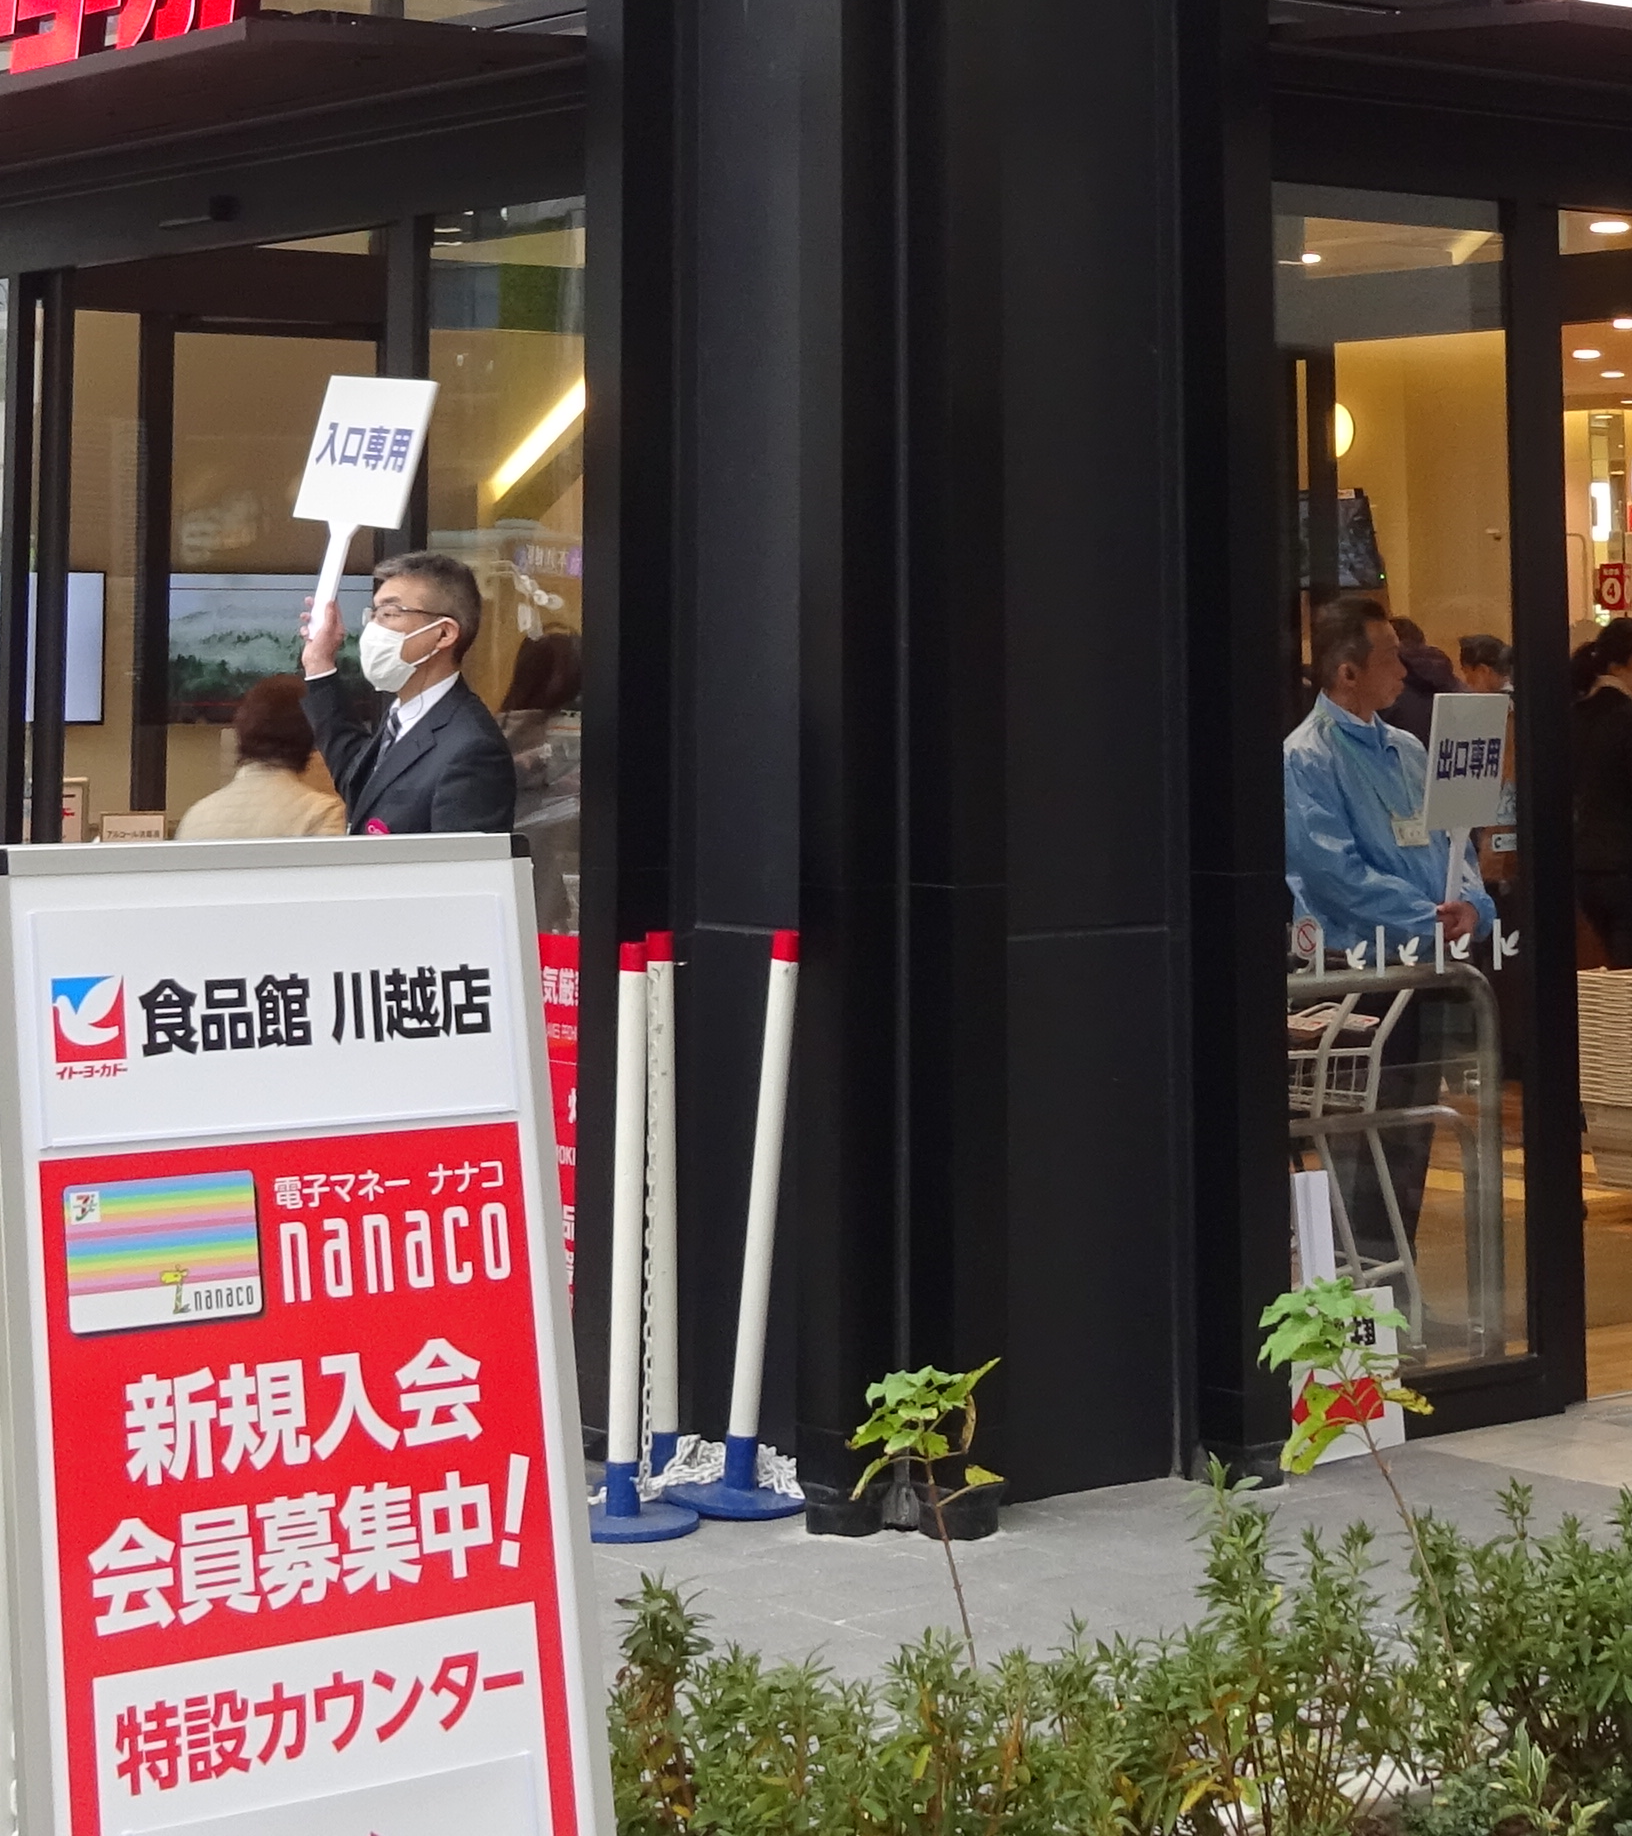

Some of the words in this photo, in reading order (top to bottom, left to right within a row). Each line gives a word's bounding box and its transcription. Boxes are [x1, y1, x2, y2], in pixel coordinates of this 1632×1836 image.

[315, 421, 416, 474] 入口専用
[1436, 737, 1502, 781] 出口専用
[137, 972, 313, 1059] 食品館
[331, 963, 493, 1045] 川越店
[55, 1062, 129, 1082] イトーヨーカドー
[273, 1168, 411, 1210] 電子マネー
[427, 1160, 505, 1196] ナナコ
[279, 1201, 512, 1304] nanaco
[193, 1284, 255, 1312] nanaco
[124, 1336, 485, 1487] 新規入会
[87, 1452, 531, 1637] 会員募集中!
[113, 1650, 526, 1798] 特設カウンター
